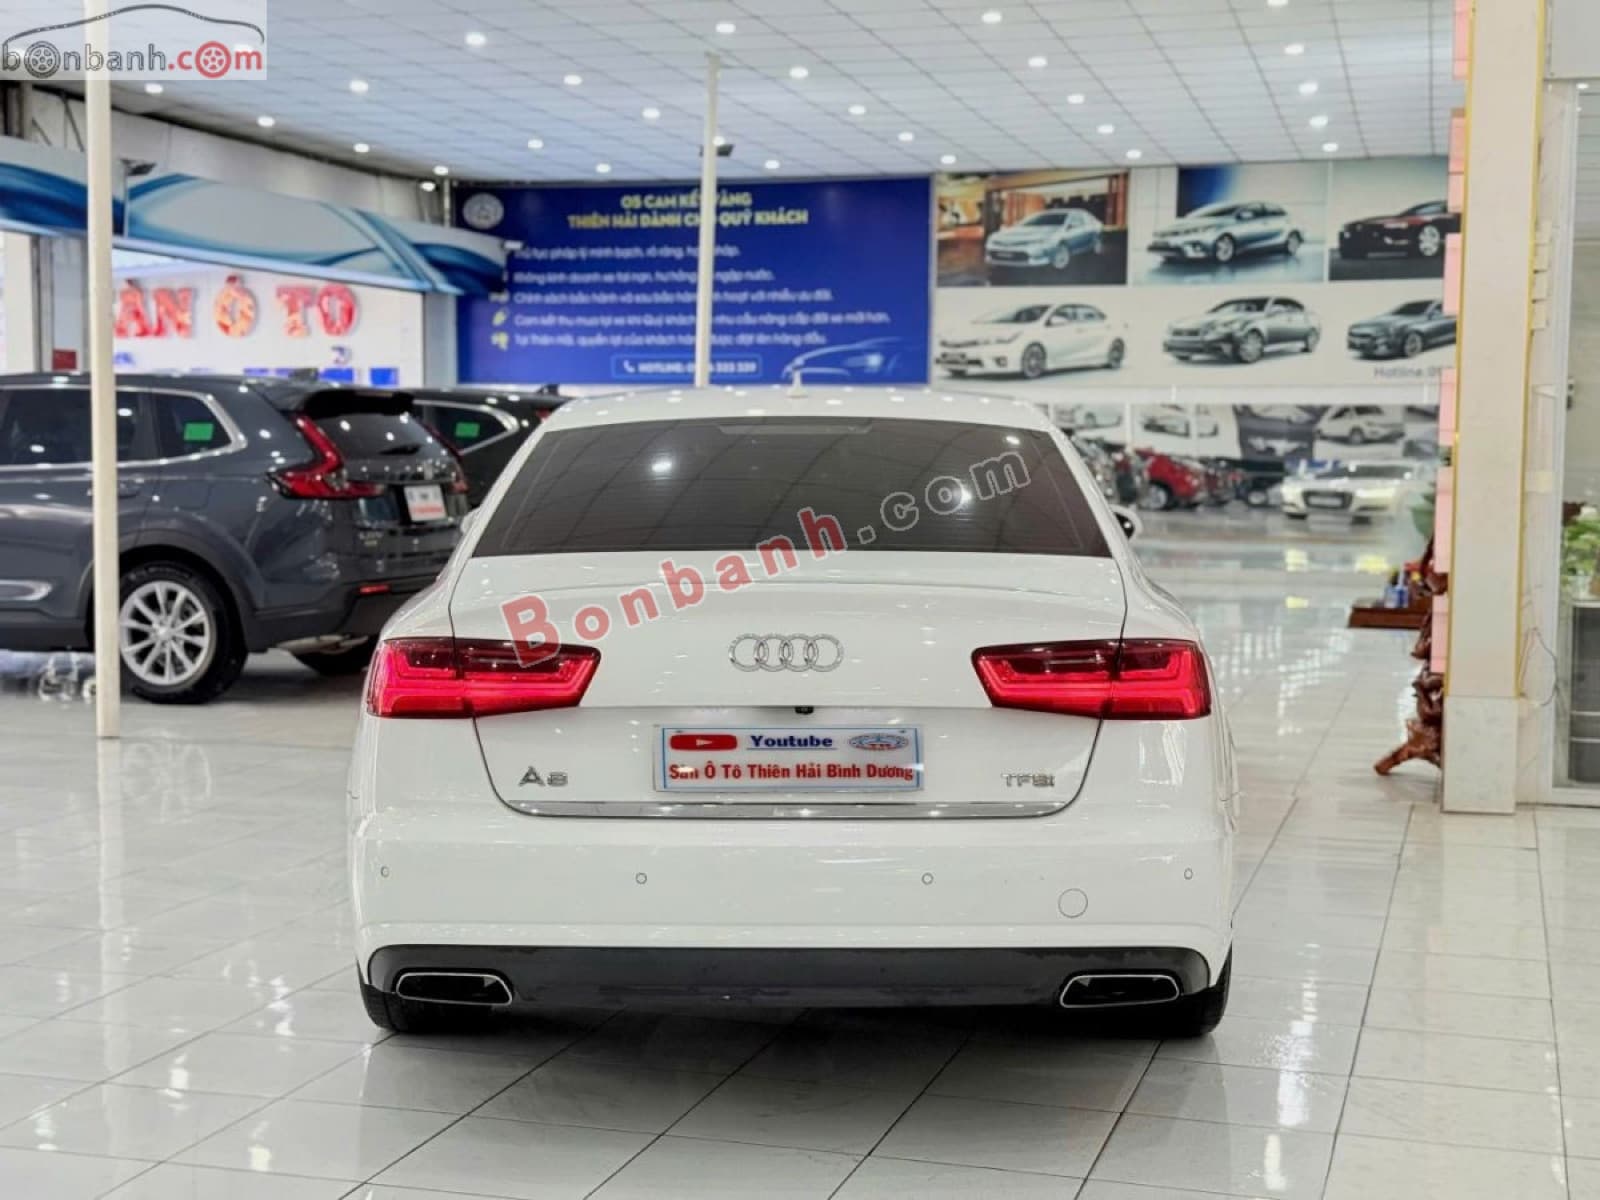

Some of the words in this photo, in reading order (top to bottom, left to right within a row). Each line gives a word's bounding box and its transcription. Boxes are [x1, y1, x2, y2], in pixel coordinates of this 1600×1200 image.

[644, 195, 677, 208] CAM
[755, 206, 809, 225] KHÁCH
[114, 278, 194, 338] ÀN
[751, 735, 833, 748] Youtube
[705, 761, 716, 780] Ô
[722, 763, 742, 780] Tô
[747, 763, 790, 779] Thiên
[796, 761, 821, 779] Hải
[827, 763, 861, 779] Bình
[867, 763, 913, 781] Dương
